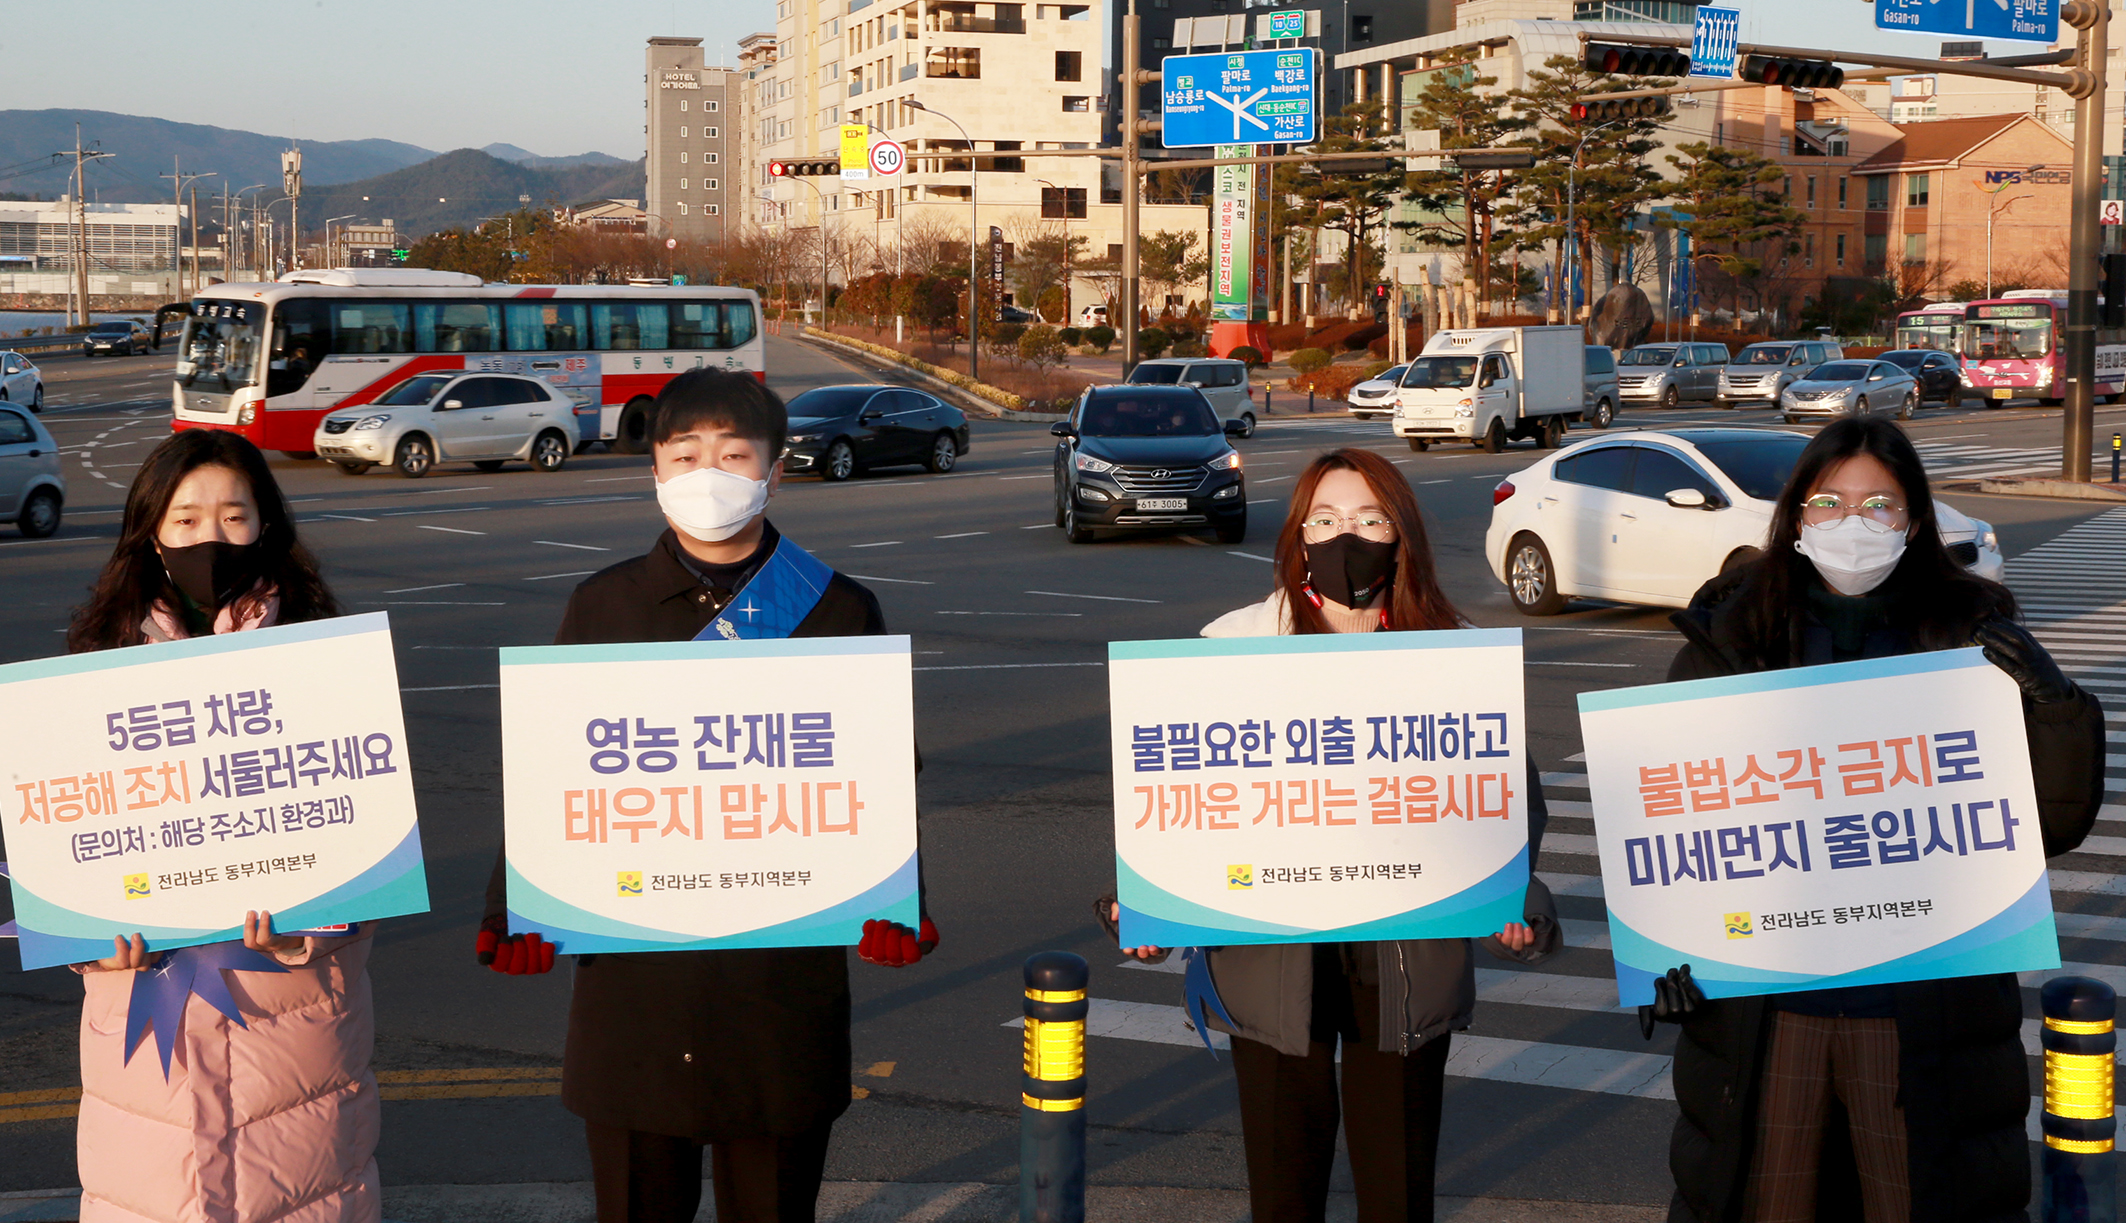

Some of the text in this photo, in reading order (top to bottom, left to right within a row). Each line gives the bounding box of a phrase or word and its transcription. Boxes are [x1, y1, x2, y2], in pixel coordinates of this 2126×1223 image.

[1884, 9, 1920, 25] Gasan-ro
[2013, 0, 2049, 18] 팔마로
[1290, 20, 1298, 28] 25
[2012, 19, 2046, 34] Palma-ro
[1229, 58, 1243, 68] 시청
[1279, 56, 1301, 67] 순천IC
[1221, 70, 1251, 85] 팔마로
[1274, 69, 1306, 83] 백강로
[1165, 89, 1205, 105] 남승룡로
[1221, 85, 1251, 93] Palma-ro
[1274, 115, 1305, 129] 가산로
[1274, 130, 1303, 139] Gasan-ro
[877, 150, 897, 166] 50
[1985, 171, 2021, 184] NPS
[1219, 201, 1233, 296] 생물권보전지역
[1911, 316, 1924, 325] 15
[565, 359, 587, 371] 제주
[1161, 500, 1182, 508] 3005
[106, 688, 284, 751] 5등급 차량,
[586, 712, 835, 774] 영농 잔재물
[1131, 712, 1510, 772] 불필요한 외출 자제하고
[15, 732, 397, 825] 저공해 조치 서둘러주세요
[1638, 729, 1984, 818] 불법소각 금지로
[1133, 772, 1514, 831] 가까운 거리는 걸읍시다
[564, 780, 865, 843] 태우지 맙시다
[71, 826, 146, 864] (문의처
[160, 818, 206, 849] 해당
[210, 807, 278, 842] 주소지
[281, 794, 355, 832] 환경과)
[1624, 798, 2020, 887] 미세먼지 줄입시다
[157, 853, 318, 891] 전라남도 동부지역본부
[1261, 862, 1422, 884] 전라남도 동부지역본부
[651, 870, 812, 891] 전라남도 동부지역본부
[1760, 898, 1934, 932] 전라남도 동부지역본부
